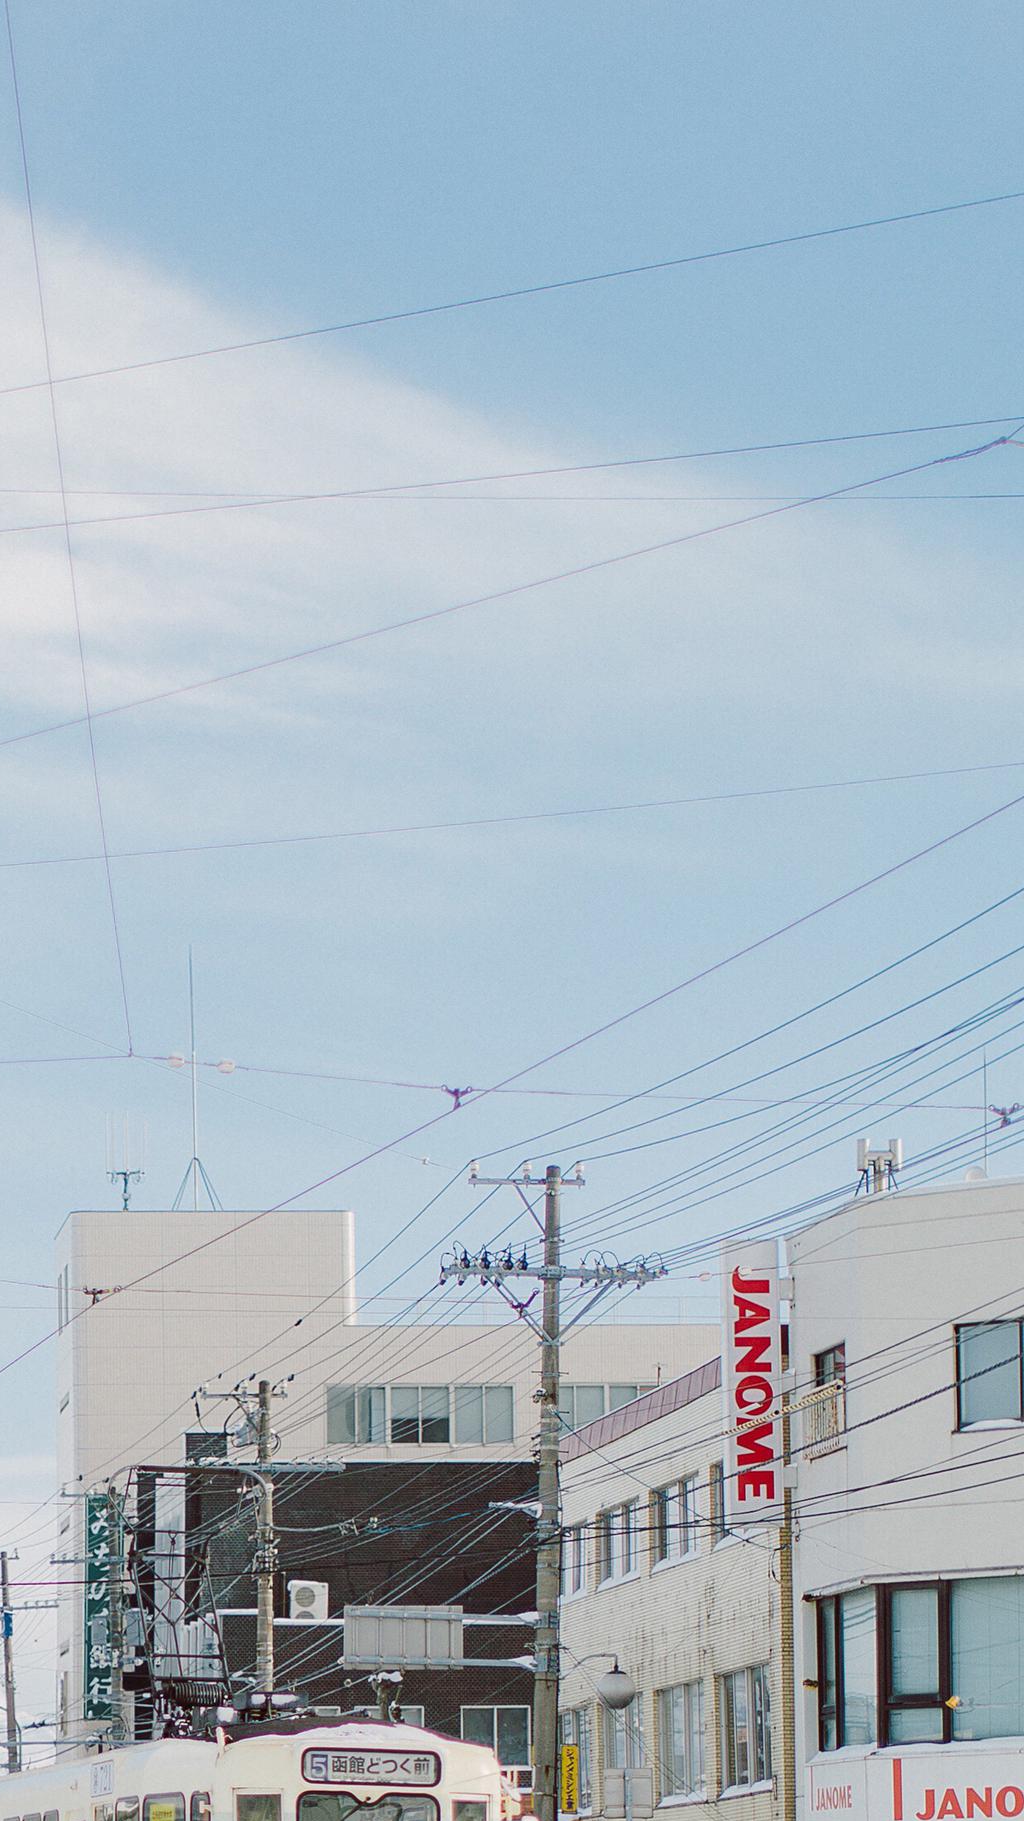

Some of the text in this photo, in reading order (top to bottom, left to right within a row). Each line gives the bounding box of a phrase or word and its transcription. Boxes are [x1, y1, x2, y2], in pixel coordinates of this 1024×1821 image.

[732, 1265, 775, 1501] JANOME
[311, 1755, 431, 1779] 5 函館どつく前
[815, 1785, 852, 1811] JANOME
[915, 1785, 1024, 1821] JANO
